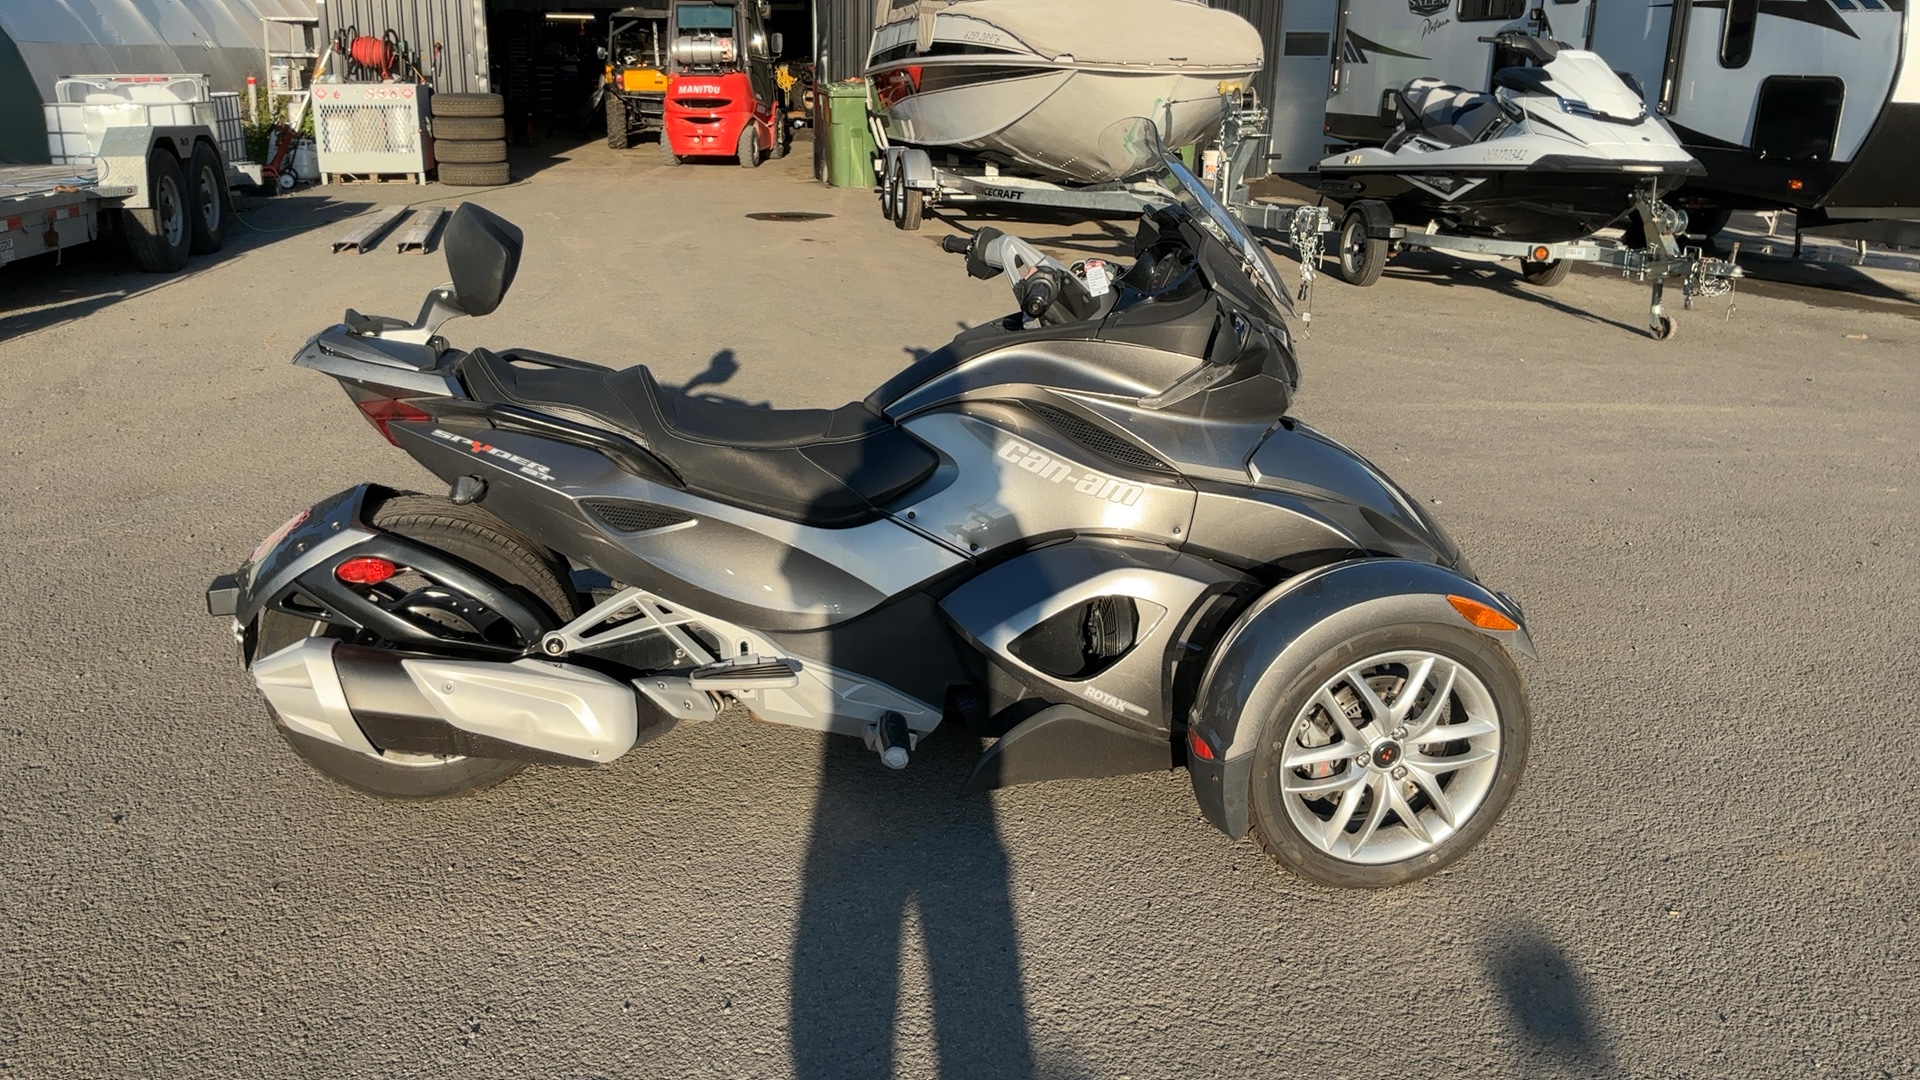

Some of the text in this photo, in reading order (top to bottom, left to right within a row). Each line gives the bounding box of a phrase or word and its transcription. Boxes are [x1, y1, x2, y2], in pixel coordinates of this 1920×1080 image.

[678, 84, 721, 96] MANITOU
[430, 429, 551, 475] SPYDER
[518, 466, 556, 482] ST
[997, 438, 1144, 507] can-am
[1084, 685, 1126, 713] ROTAX
